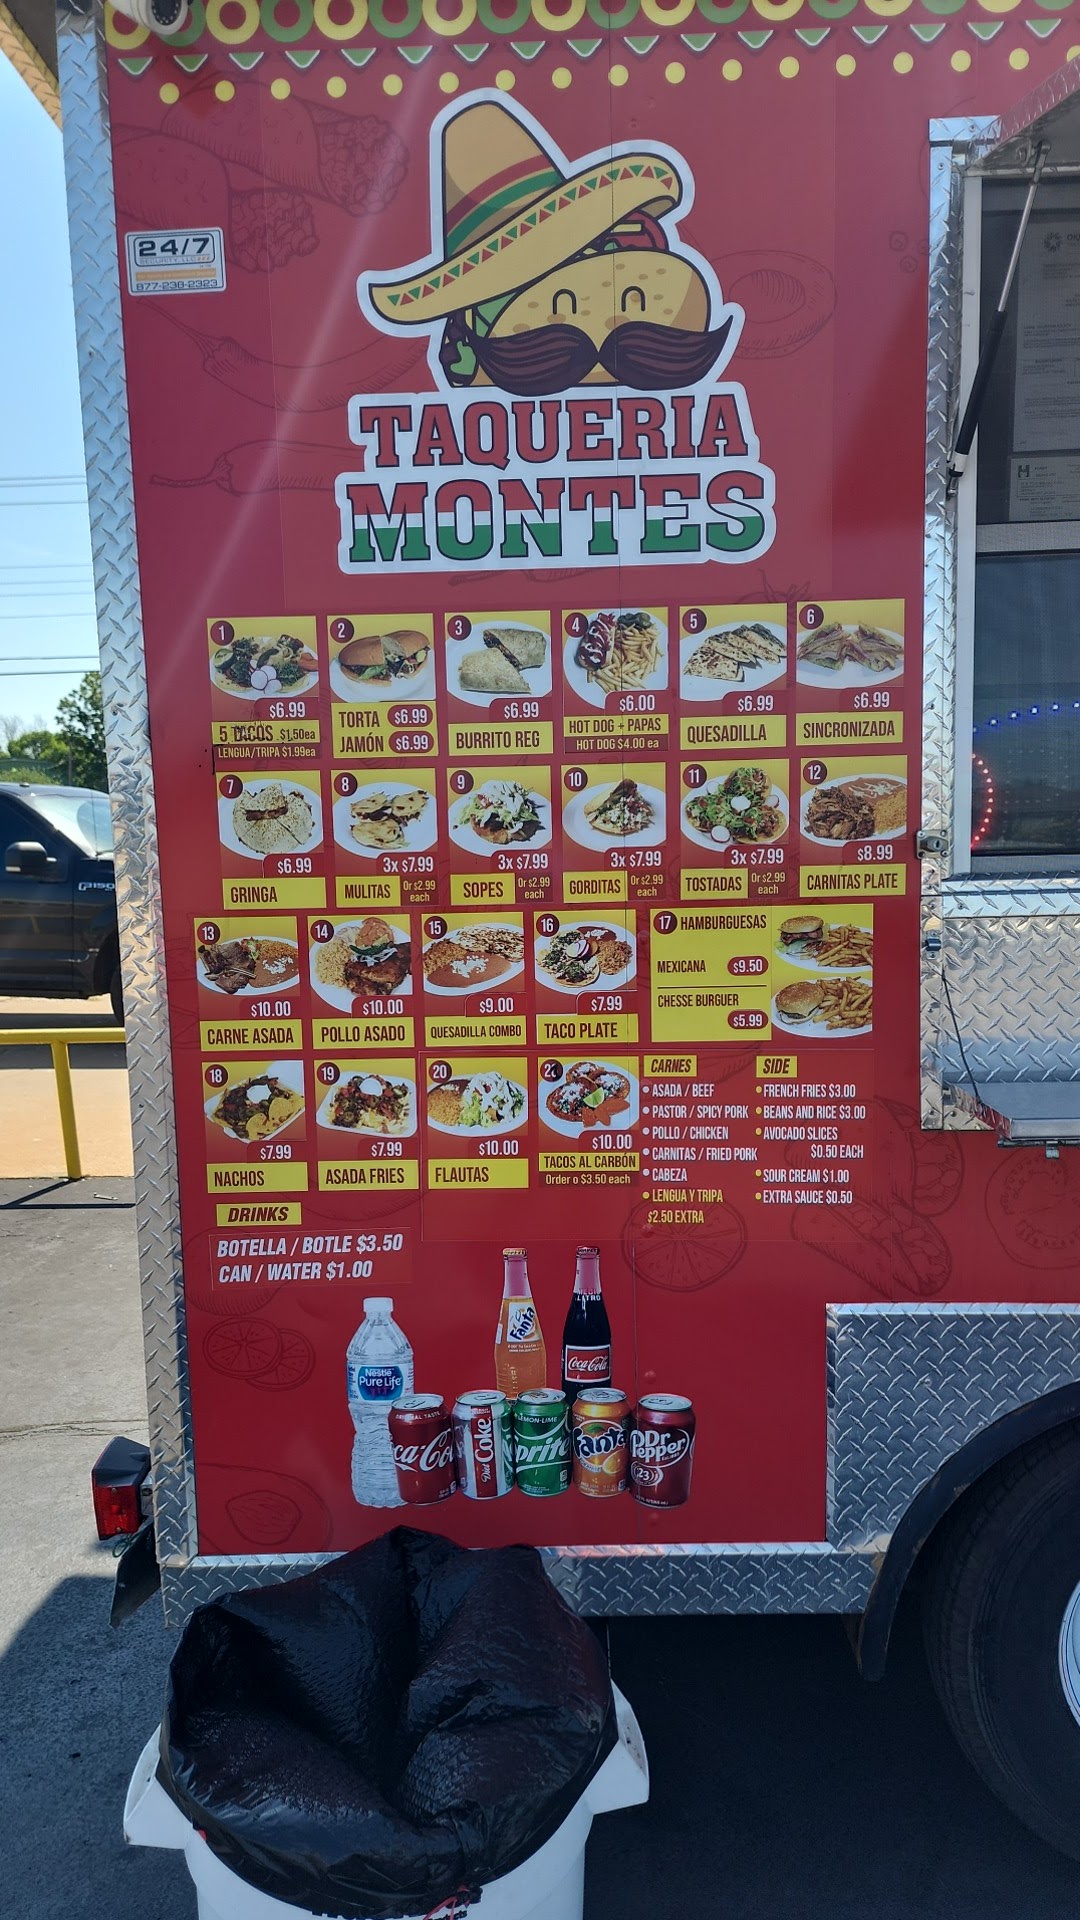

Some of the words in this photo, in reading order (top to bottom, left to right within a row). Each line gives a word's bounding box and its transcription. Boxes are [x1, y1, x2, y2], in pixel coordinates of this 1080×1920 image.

[138, 238, 210, 257] 24/7
[136, 279, 218, 290] 877-238-2323
[359, 394, 748, 470] TAQUERIA
[346, 469, 765, 562] MONTES
[619, 695, 655, 712] $6.00
[738, 695, 774, 712] $6.99
[854, 692, 890, 708] $6.99
[269, 702, 306, 719] $6.99
[394, 708, 428, 725] $6.99
[504, 702, 539, 719] $6.99
[339, 711, 380, 728] TORTA
[569, 720, 590, 734] HOT
[592, 720, 614, 733] DOG
[628, 718, 661, 732] PAPAS
[220, 726, 227, 743] 5
[687, 724, 767, 744] QUESADILLA
[804, 721, 895, 739] SINCRONIZADA
[340, 732, 384, 753] JAMÓN
[395, 735, 428, 751] $6.99
[456, 732, 511, 749] BURRITO
[516, 731, 540, 747] REG
[576, 739, 595, 750] HOT
[597, 739, 615, 750] DOG
[617, 738, 644, 750] $4.00
[218, 747, 280, 759] LENGUA/TRIPA
[282, 746, 316, 758] $1.99ea
[568, 772, 582, 787] 10
[688, 768, 700, 784] 11
[808, 765, 821, 780] 12
[610, 853, 626, 867] 3x
[630, 851, 661, 868] $7.99
[731, 850, 747, 865] 3x
[751, 849, 784, 865] $7.99
[857, 845, 893, 862] $8.99
[277, 858, 312, 874] $6.99
[383, 858, 398, 873] 3x
[402, 857, 433, 873] $7.99
[498, 855, 513, 870] 3x
[517, 854, 548, 870] $7.99
[414, 880, 435, 892] $2.99
[529, 877, 550, 889] $2.99
[641, 874, 663, 886] $2.99
[686, 877, 742, 892] TOSTADAS
[762, 872, 785, 884] $2.99
[807, 874, 861, 890] CARNITAS
[864, 873, 898, 889] PLATE
[230, 886, 277, 904] GRINGA
[345, 884, 390, 900] MULITAS
[464, 882, 504, 898] SOPES
[524, 889, 544, 900] each
[569, 879, 621, 895] GORDITAS
[637, 886, 657, 897] each
[758, 884, 779, 895] each
[410, 892, 430, 903] each
[429, 920, 442, 935] 15
[541, 918, 554, 932] 16
[659, 915, 671, 930] 17
[680, 915, 767, 930] HAMBURGUESAS
[202, 926, 215, 942] 13
[316, 924, 328, 939] 14
[657, 960, 706, 974] MEXICANA
[733, 959, 763, 973] $9.50
[363, 999, 403, 1015] $10.00
[479, 997, 514, 1013] $9.00
[591, 996, 623, 1012] $7.99
[658, 995, 693, 1007] CHESSE
[696, 994, 739, 1007] BURGUER
[251, 1001, 291, 1017] $10.00
[733, 1014, 763, 1027] $5.99
[207, 1029, 250, 1045] CARNE
[252, 1028, 294, 1044] ASADA
[322, 1027, 361, 1043] POLLO
[364, 1026, 405, 1041] ASADO
[431, 1026, 487, 1039] QUESADILLA
[489, 1024, 522, 1037] COMBO
[545, 1023, 576, 1039] TACO
[580, 1022, 618, 1038] PLATE
[322, 1066, 334, 1082] 19
[433, 1065, 447, 1080] 20
[651, 1059, 691, 1073] CARNES
[763, 1058, 790, 1074] SIDE
[210, 1068, 222, 1084] 18
[652, 1085, 682, 1097] ASADA
[693, 1084, 714, 1096] BEEF
[763, 1085, 799, 1097] FRENCH
[801, 1085, 826, 1097] FRIES
[828, 1084, 856, 1098] $3.00
[652, 1106, 686, 1118] PASTOR
[697, 1106, 722, 1118] SPICY
[724, 1106, 749, 1118] PORK
[763, 1106, 795, 1119] BEANS
[797, 1106, 814, 1119] AND
[817, 1106, 837, 1119] RICE
[839, 1105, 866, 1120] $3.00
[652, 1128, 680, 1140] POLLO
[690, 1127, 728, 1139] CHICKEN
[763, 1128, 805, 1140] AVOCADO
[808, 1127, 838, 1140] SLICES
[371, 1142, 402, 1158] $7.99
[479, 1140, 519, 1156] $10.00
[592, 1135, 632, 1150] $10.00
[260, 1145, 292, 1160] $7.99
[652, 1148, 696, 1160] CARNITAS
[706, 1148, 733, 1160] FRIED
[736, 1148, 758, 1161] PORK
[810, 1145, 837, 1159] $0.50
[840, 1145, 864, 1158] EACH
[544, 1156, 576, 1169] TACOS
[579, 1155, 591, 1168] AL
[595, 1153, 636, 1168] CARBÓN
[214, 1171, 264, 1186] NACHOS
[326, 1169, 366, 1184] ASADA
[370, 1168, 404, 1183] FRIES
[435, 1167, 489, 1183] FLAUTAS
[546, 1175, 570, 1185] Order
[581, 1174, 606, 1186] $3.50
[608, 1174, 630, 1185] each
[652, 1169, 687, 1181] CABEZA
[763, 1170, 788, 1182] SOUR
[790, 1170, 821, 1182] CREAM
[822, 1169, 849, 1184] $1.00
[652, 1190, 687, 1202] LENGUA
[697, 1190, 723, 1202] TRIPA
[763, 1191, 792, 1204] EXTRA
[795, 1191, 824, 1203] SAUCE
[826, 1191, 852, 1205] $0.50
[228, 1207, 289, 1222] DRINKS
[648, 1210, 673, 1224] $2.50
[675, 1211, 704, 1223] EXTRA
[217, 1238, 287, 1257] BOTELLA
[302, 1236, 352, 1254] BOTLE
[356, 1234, 403, 1253] $3.50
[219, 1265, 252, 1283] CAN
[267, 1263, 322, 1281] WATER
[326, 1260, 373, 1280] $1.00
[510, 1307, 535, 1340] Fanta
[360, 1376, 383, 1386] Pure
[385, 1376, 401, 1390] Life
[475, 1418, 493, 1463] Coke
[573, 1427, 627, 1458] Fanta
[482, 1464, 491, 1482] Diet
[638, 1468, 649, 1480] 23
